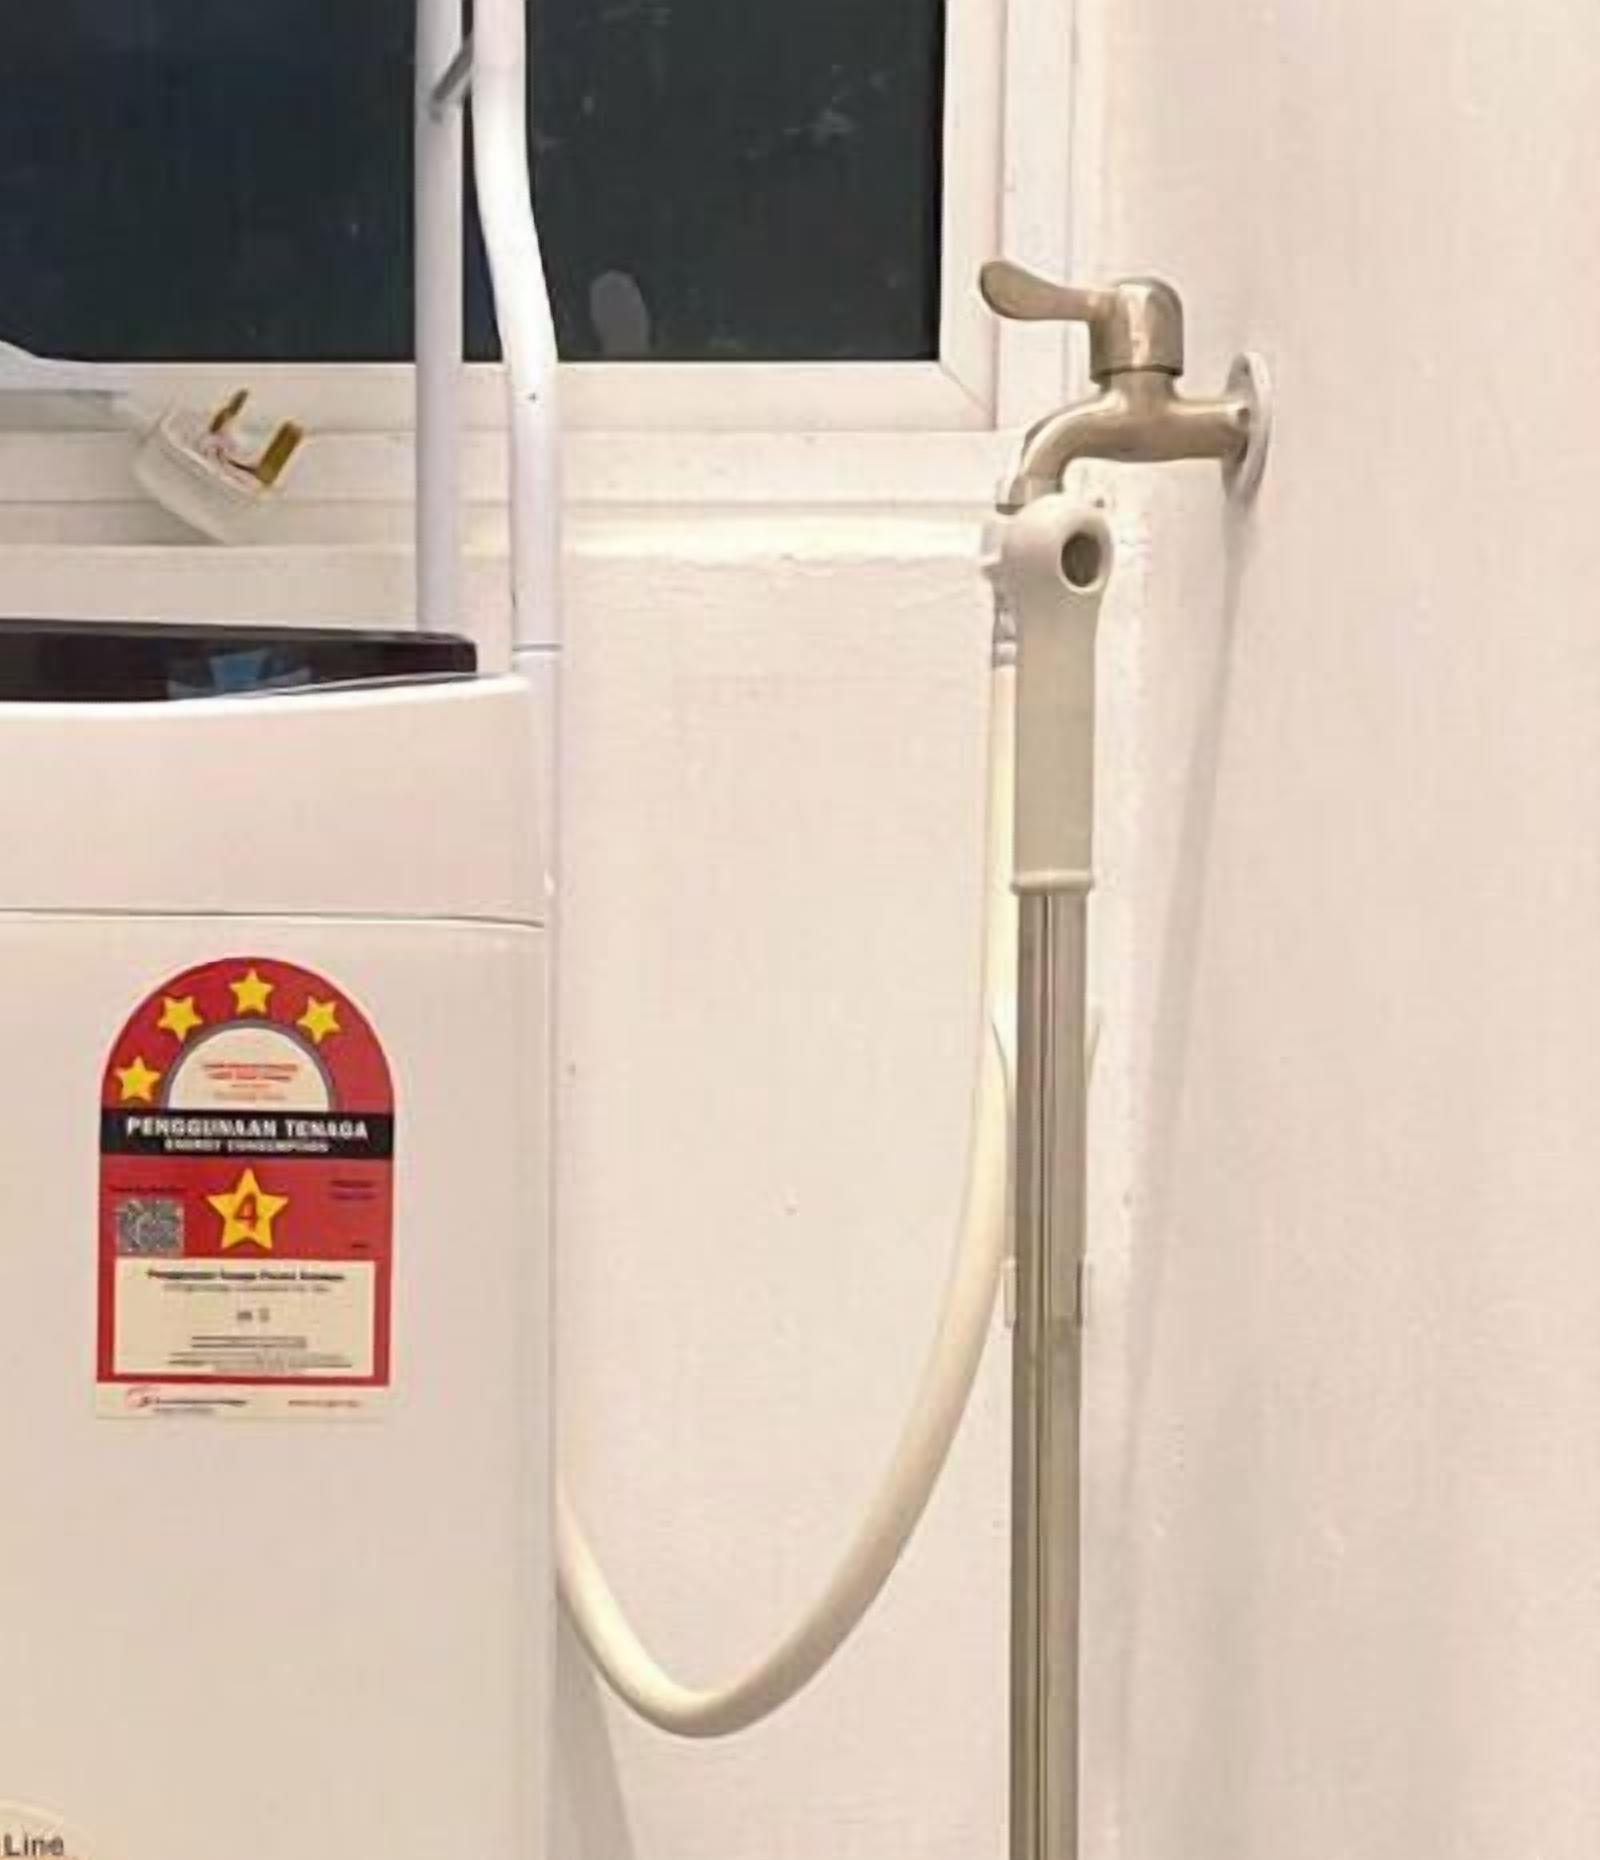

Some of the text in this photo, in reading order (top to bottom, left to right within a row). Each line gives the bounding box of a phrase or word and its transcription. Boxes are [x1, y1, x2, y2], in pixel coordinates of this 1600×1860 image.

[126, 1116, 369, 1140] PENGGUNAAN TENAGA
[234, 1193, 259, 1233] 4
